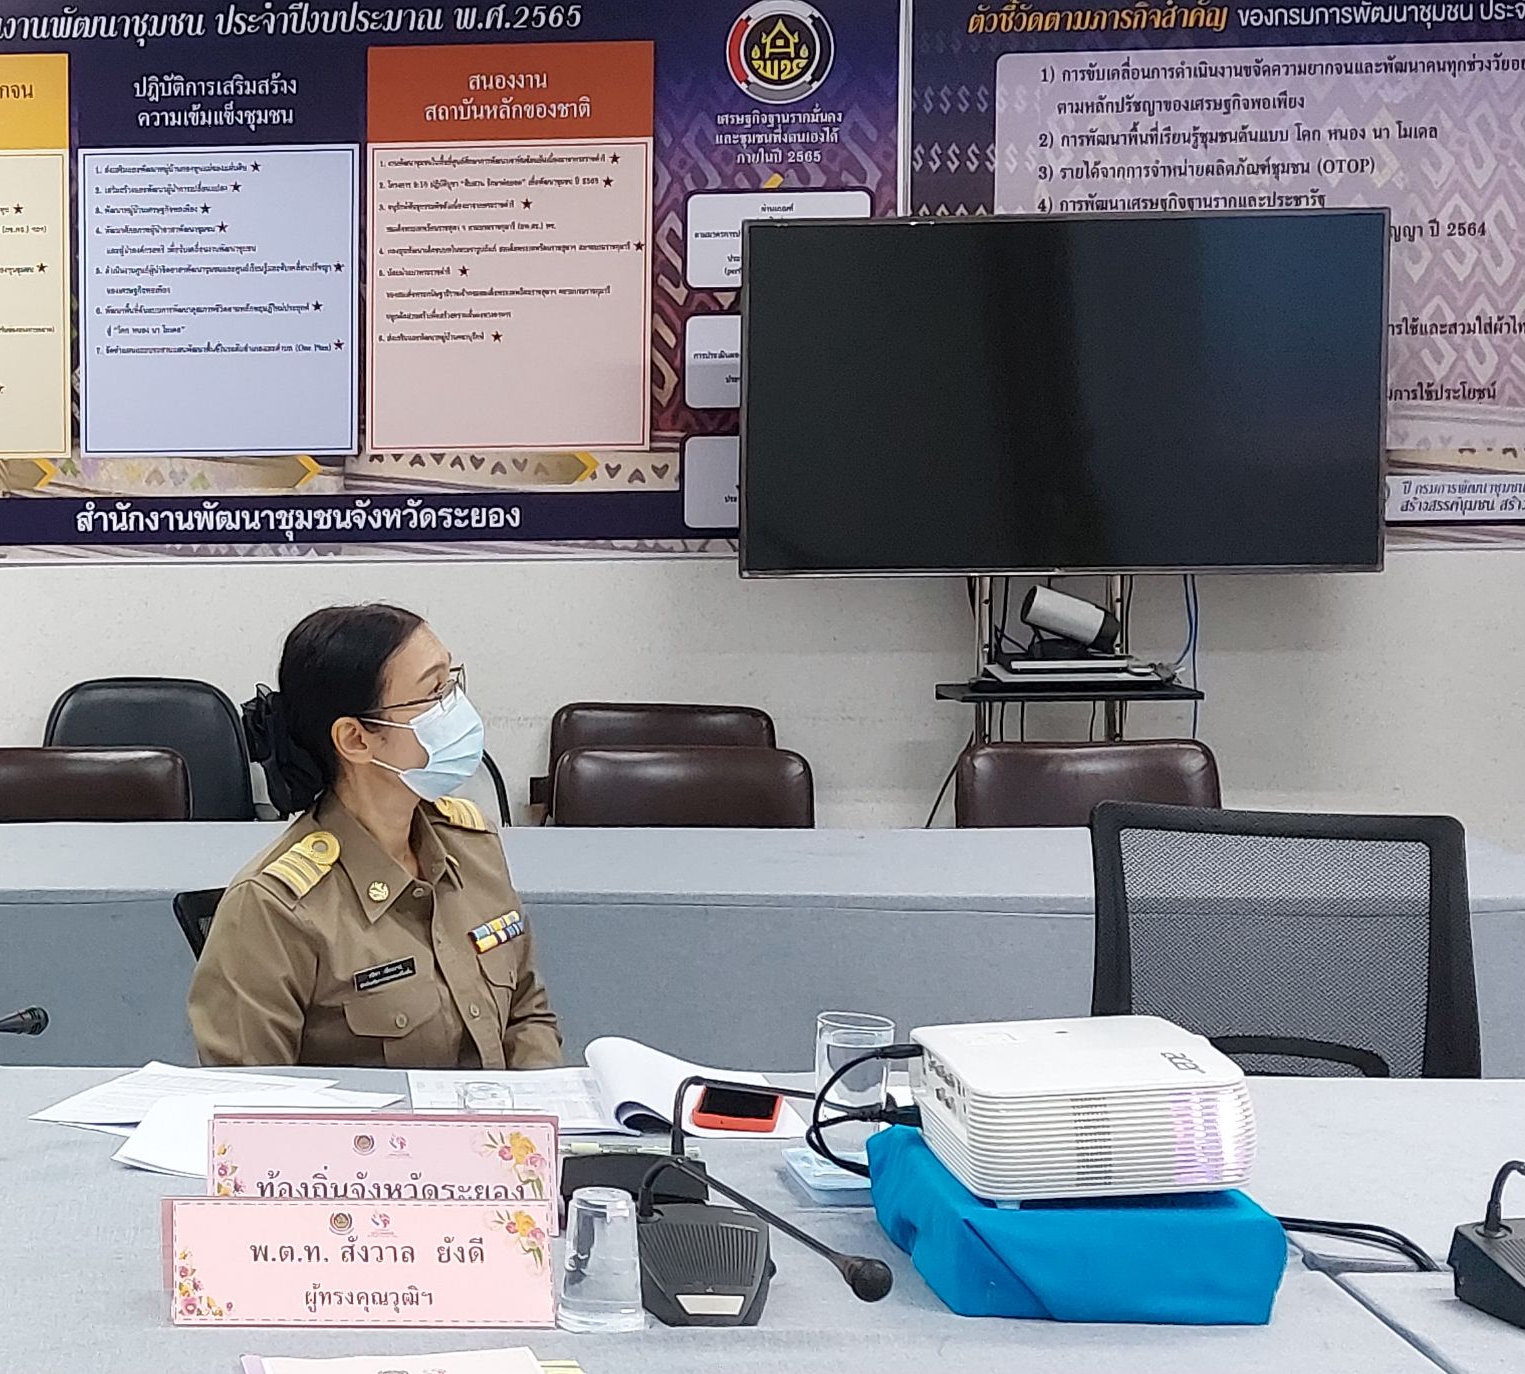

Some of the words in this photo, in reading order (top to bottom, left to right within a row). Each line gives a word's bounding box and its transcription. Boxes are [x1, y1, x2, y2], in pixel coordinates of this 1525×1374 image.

[216, 3, 443, 35] ประจำปีงบประมาณ
[1237, 1, 1474, 30] ของกรมการพัฒนาชุมชน
[133, 72, 298, 101] ปฏิบัติการเสริมสร้าง
[468, 72, 547, 91] สนองงาน
[1040, 67, 1055, 84] 1)
[138, 101, 294, 131] ความเข้มแข็งชุมชน
[425, 96, 591, 121] สถาบันหลักของชาติ
[717, 103, 842, 128] เศรษฐกิจฐานรากมั่นคง
[1057, 91, 1305, 117] ตามหลักปรัชญาของเศรษฐกิจพอเพียง
[716, 127, 839, 149] และชุมชนพึ่งตนเองได้
[1039, 133, 1054, 149] 2)
[1061, 121, 1288, 150] การพัฒนาพื้นที่เรียนรู้ชุมชนต้นแบบ
[1295, 123, 1321, 142] โคก
[1328, 127, 1366, 141] หนอง
[1372, 126, 1390, 139] นา
[1396, 120, 1438, 139] โมเดล
[737, 149, 782, 164] ภายในปี
[788, 151, 821, 162] 2565
[1038, 165, 1053, 181] 3)
[1060, 156, 1310, 181] รายได้จากการจำหน่ายผลิตภัณฑ์ชุมชน
[1317, 156, 1375, 176] (OTOP)
[1037, 198, 1053, 213] 4)
[1430, 218, 1440, 236] ปี
[1447, 222, 1486, 236] 2564
[76, 499, 520, 541] สำนักงานพัฒนาชุมชนจังหวัดระยอง
[1161, 1051, 1206, 1074] acer
[256, 1166, 526, 1200] ท้องถิ่นจังหวัดระยอง
[250, 1241, 329, 1264] พ.ต.ท.
[341, 1235, 415, 1264] สังวาล
[437, 1238, 485, 1264] ยังดี
[305, 1283, 433, 1313] ผู้ทรงคุณวุฒิฯ
